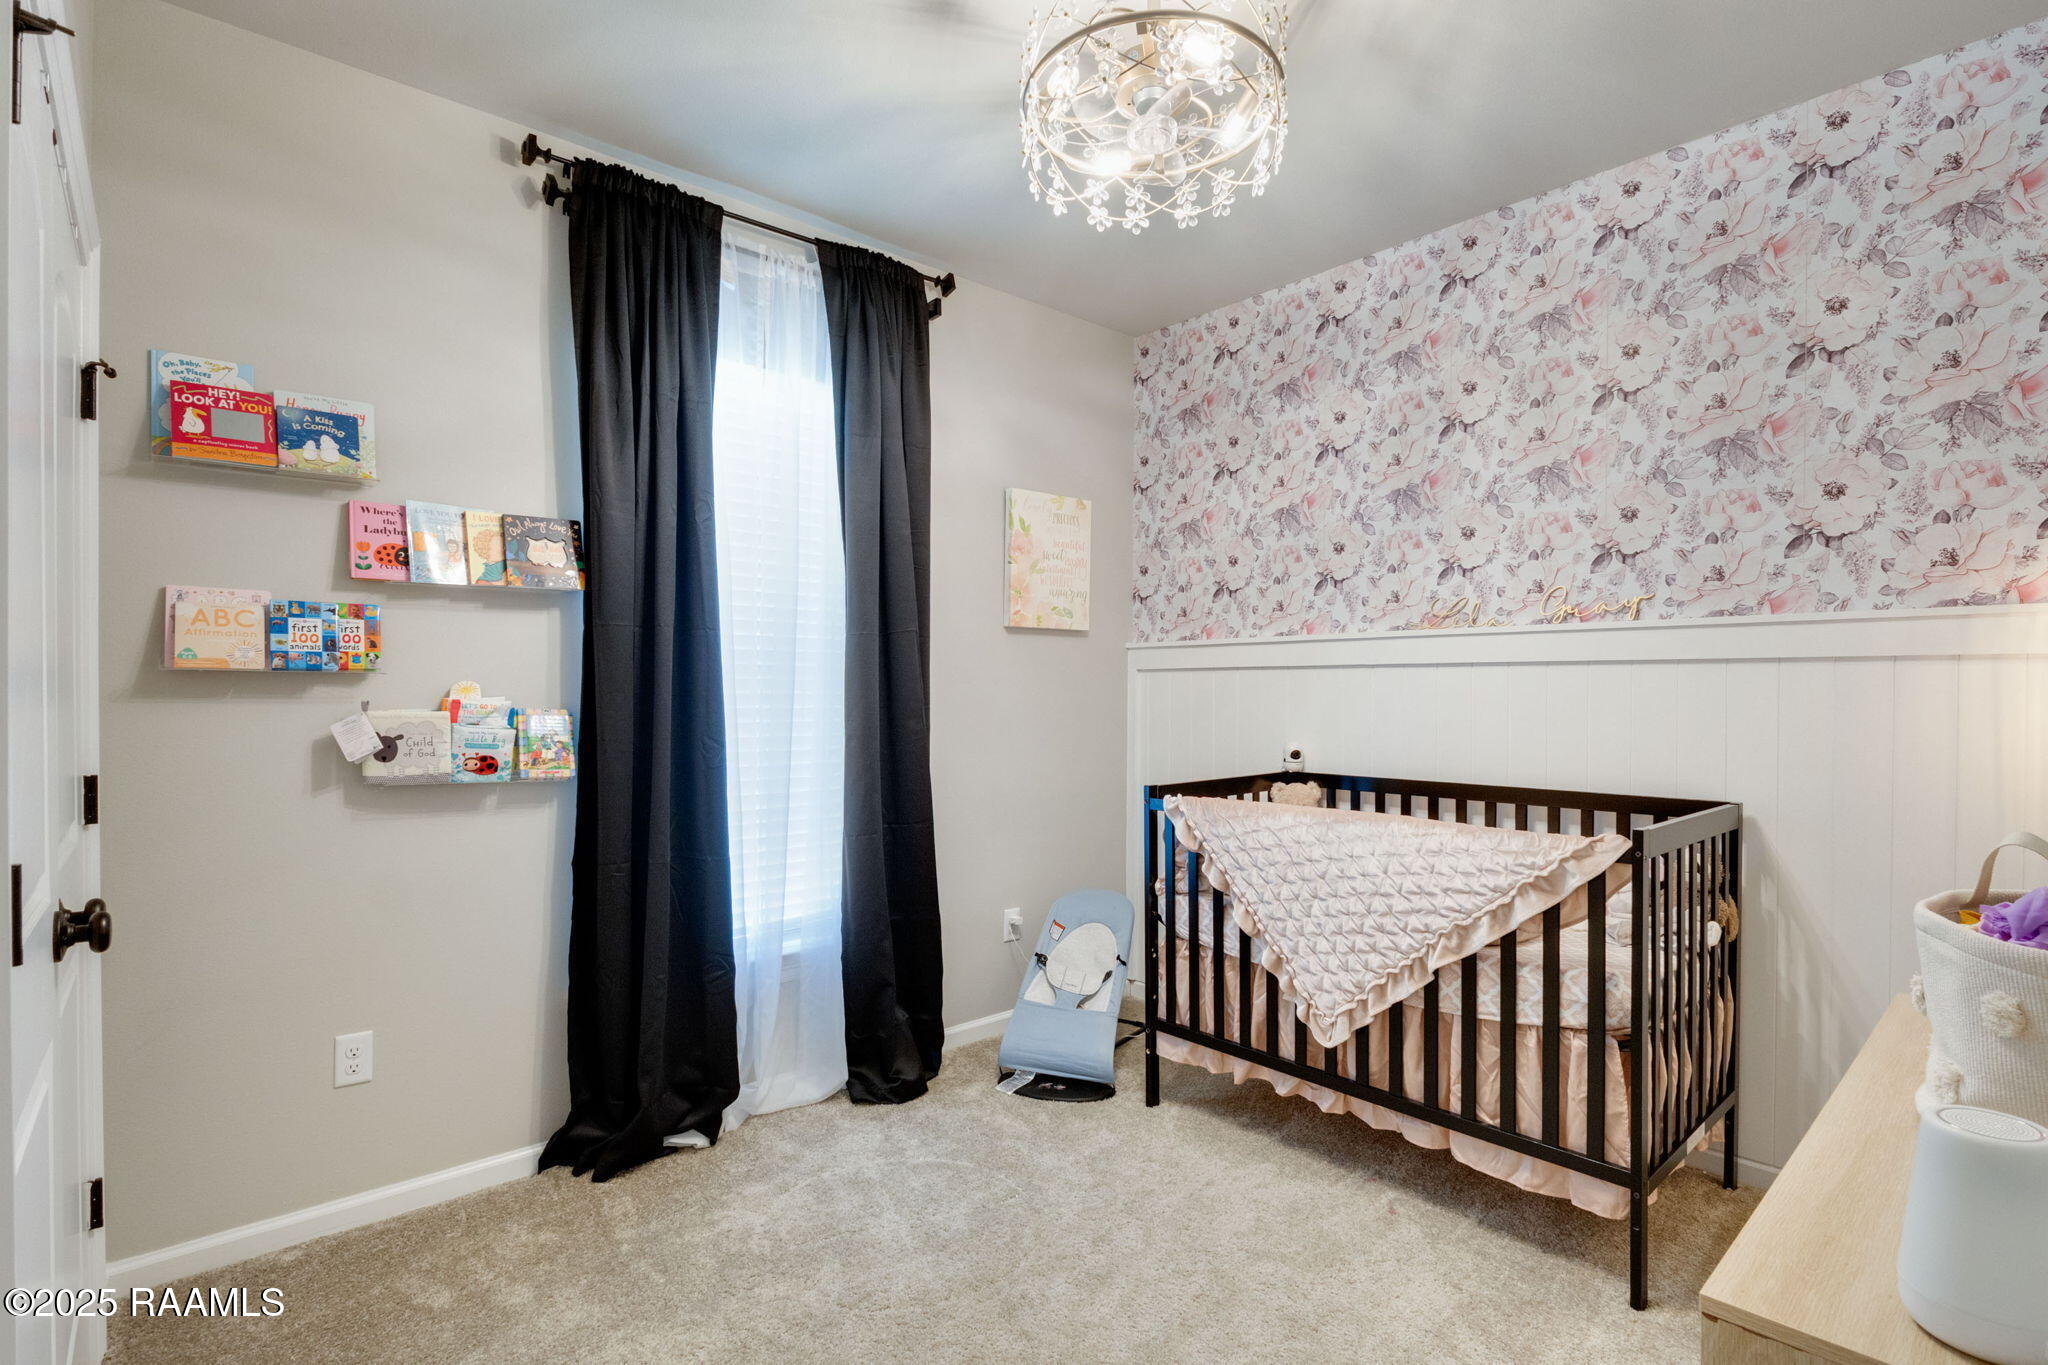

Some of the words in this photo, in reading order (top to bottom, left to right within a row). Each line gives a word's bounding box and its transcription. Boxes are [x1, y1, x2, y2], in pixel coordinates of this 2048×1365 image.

[185, 368, 212, 379] Places
[207, 387, 240, 401] HEY!
[174, 392, 215, 407] LOOK
[218, 399, 236, 410] AT
[239, 401, 273, 415] YOU!
[315, 415, 334, 426] Kiss
[302, 422, 346, 438] Coming
[360, 506, 404, 518] Where's
[363, 525, 407, 537] Ladybu
[549, 521, 567, 534] Love
[191, 607, 256, 628] ABC
[184, 628, 257, 638] Affirmation
[291, 623, 318, 633] first
[340, 625, 361, 633] irst
[290, 632, 320, 644] 100
[342, 633, 361, 644] 00
[289, 643, 322, 651] animals
[403, 748, 413, 757] of
[417, 748, 436, 757] God
